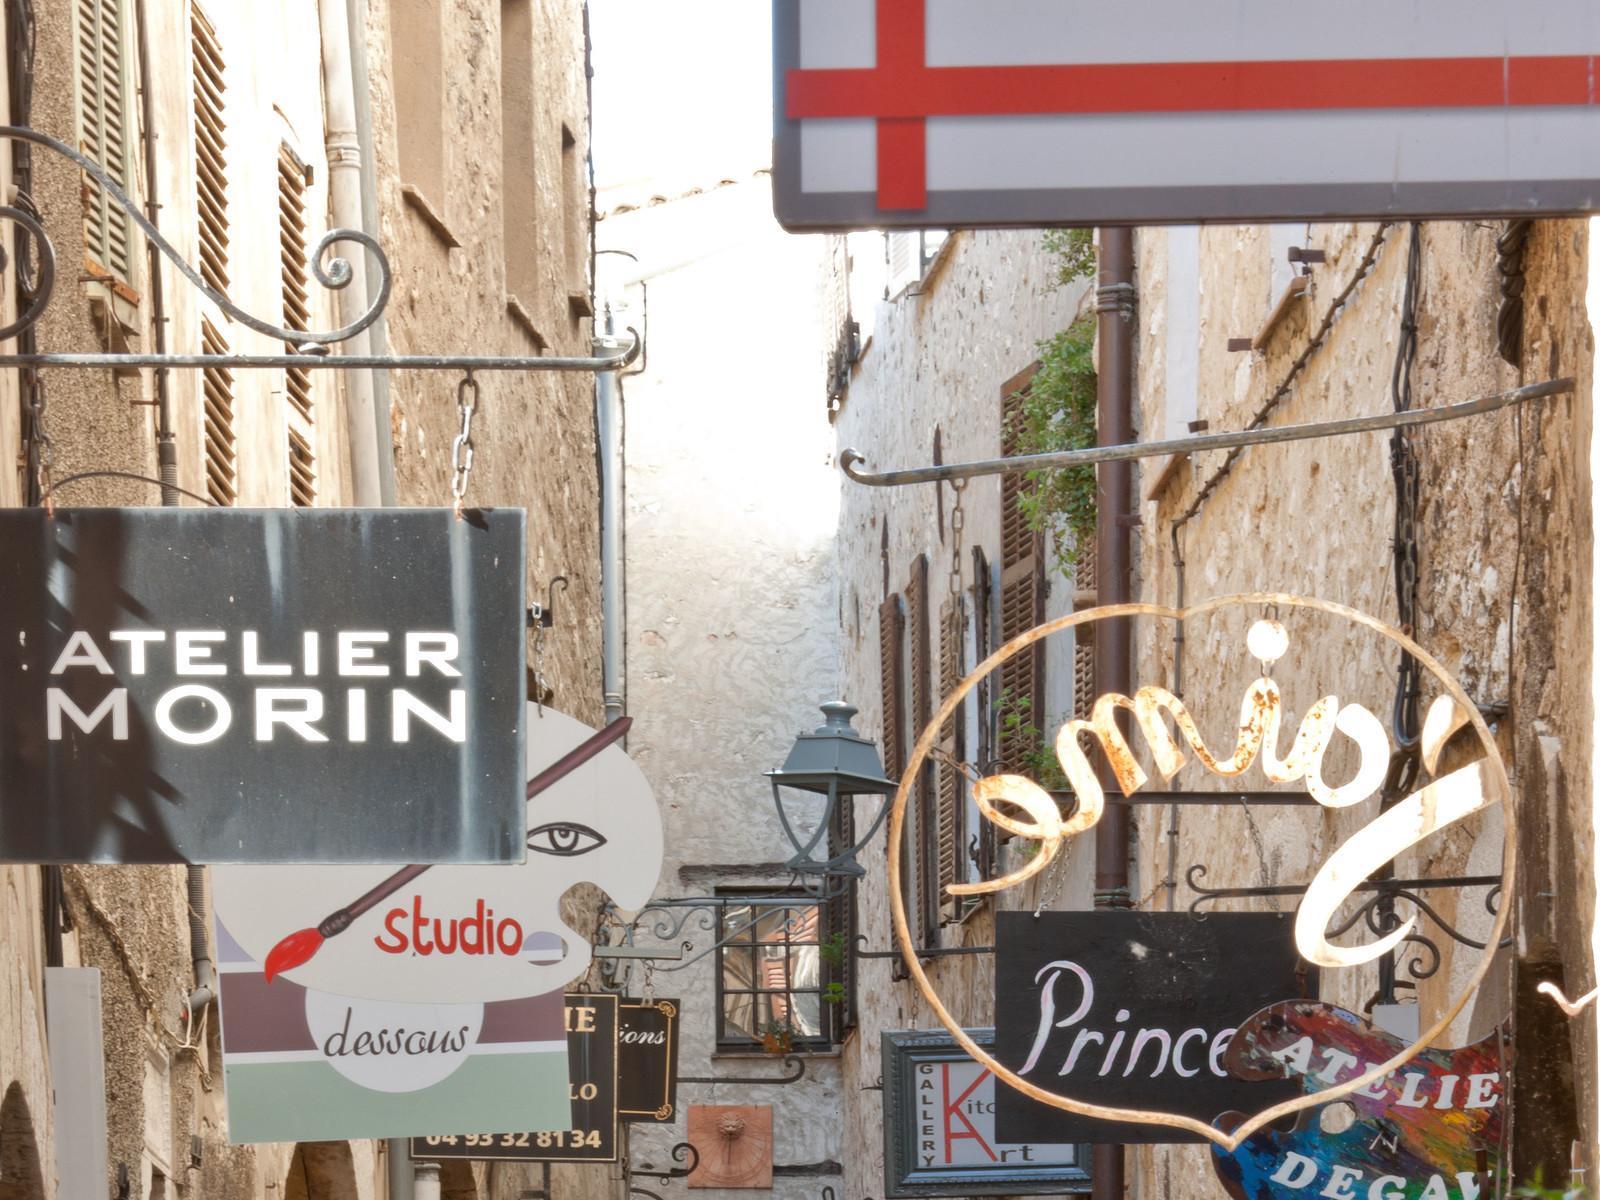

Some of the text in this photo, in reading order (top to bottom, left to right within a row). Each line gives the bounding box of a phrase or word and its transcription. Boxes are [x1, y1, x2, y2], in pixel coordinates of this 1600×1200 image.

[50, 630, 463, 677] ATELIER
[46, 684, 466, 745] MORIN
[374, 895, 523, 956] studio
[324, 1006, 469, 1057] dessous
[1017, 960, 1238, 1078] Prince
[570, 1129, 602, 1148] 34
[919, 1063, 937, 1167] GALLERY
